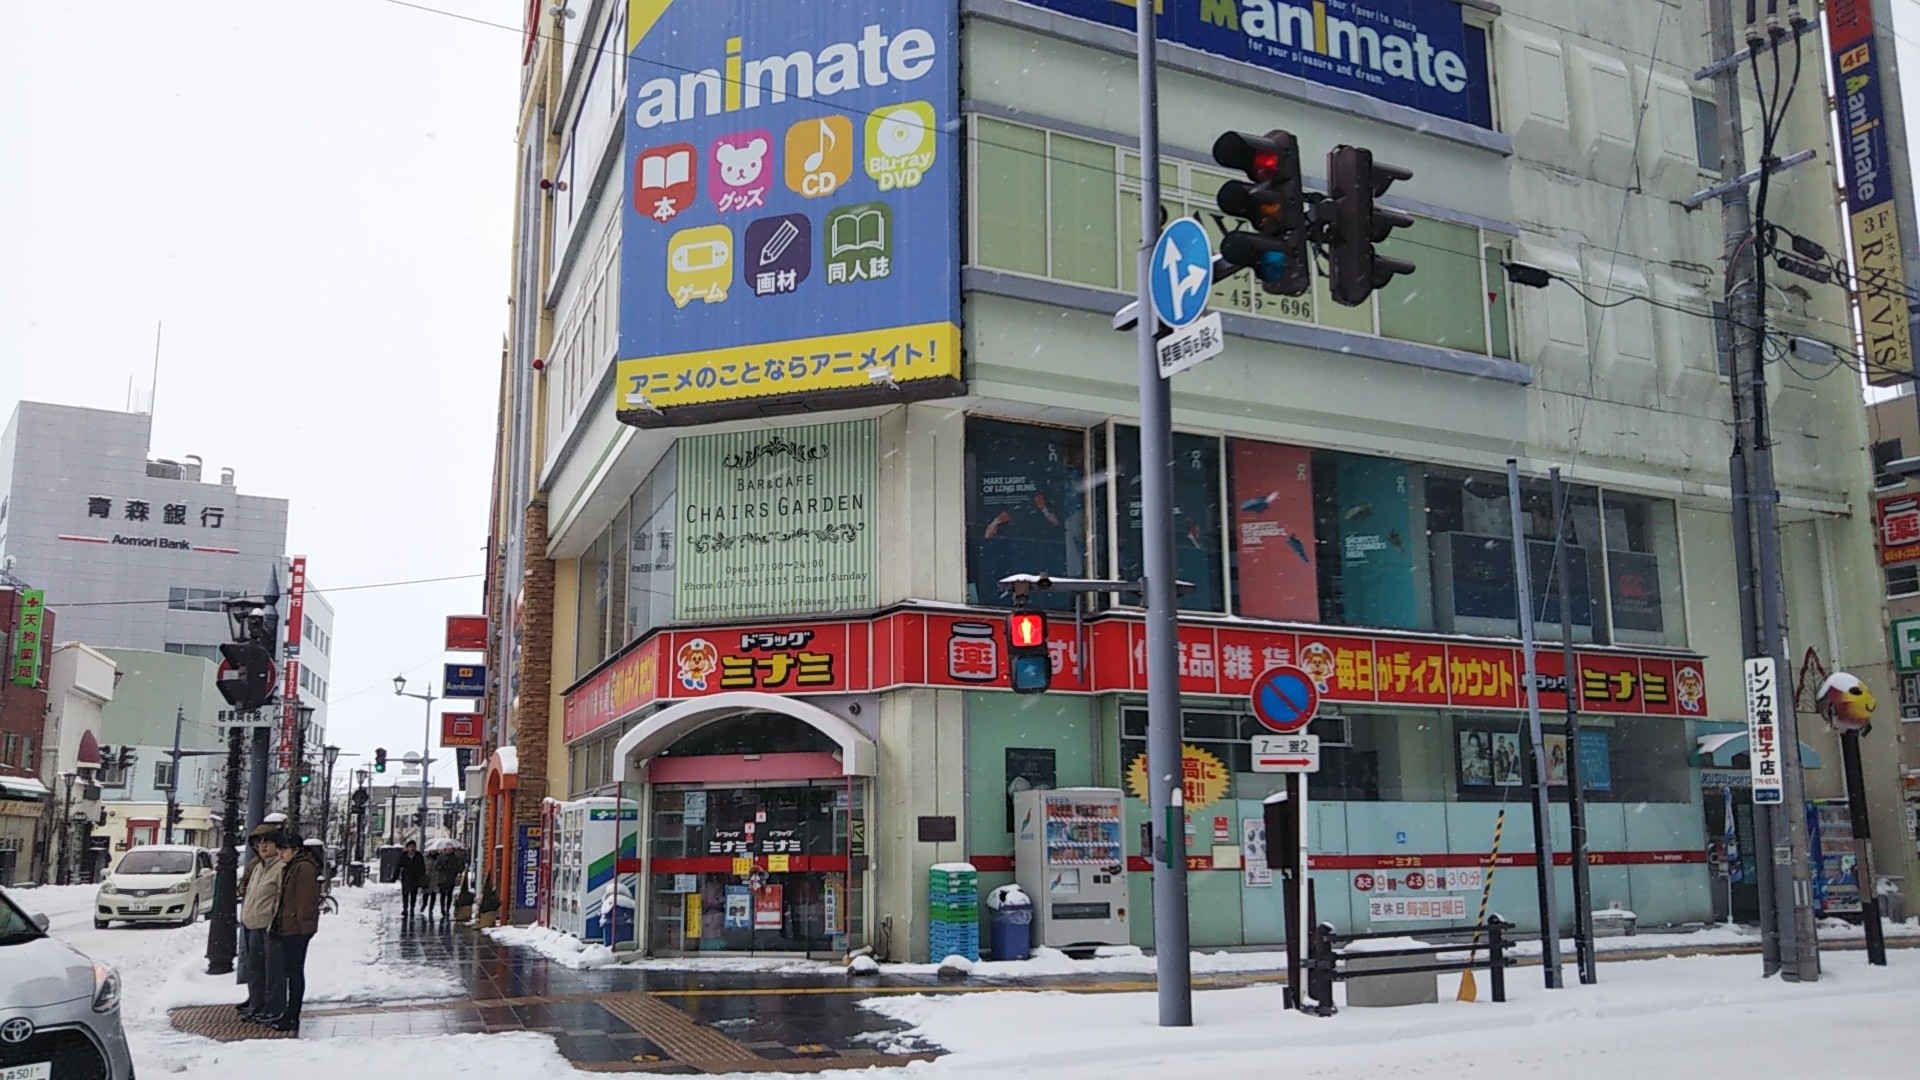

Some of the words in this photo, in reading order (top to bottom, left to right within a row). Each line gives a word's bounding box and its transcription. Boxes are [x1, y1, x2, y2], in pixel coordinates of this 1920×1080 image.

[1351, 4, 1389, 25] favorite
[1393, 17, 1417, 32] space
[1241, 0, 1467, 93] animate
[1248, 37, 1263, 51] for
[1267, 45, 1287, 58] your
[1292, 51, 1333, 72] pleasure
[1336, 63, 1352, 76] and
[1842, 47, 1866, 68] 4F
[635, 24, 936, 129] animate
[1848, 94, 1880, 202] animate
[801, 172, 837, 196] CD
[879, 169, 923, 191] DVD
[653, 196, 677, 221] 本
[718, 187, 764, 213] グッズ
[1863, 210, 1890, 234] 3F
[756, 269, 797, 295] 画材
[828, 256, 891, 285] 同人誌
[676, 282, 726, 304] ゲーム
[737, 474, 814, 492] BAR&CAFE
[87, 494, 225, 529] 青森銀行
[687, 502, 769, 524] CHAIRS
[778, 494, 863, 516] GARDEN
[112, 533, 157, 548] Aomori
[159, 538, 190, 550] Bank
[684, 582, 713, 591] Phone
[793, 572, 867, 584] Close/Sunday
[726, 565, 749, 575] Open
[18, 613, 38, 678] 天狗薬局
[741, 631, 811, 649] ドラッグ
[721, 653, 831, 686] ミナミ
[953, 641, 993, 675] 薬
[1336, 647, 1513, 698] 毎日がディスカウント
[1583, 669, 1668, 700] ミナミ
[709, 840, 748, 853] ミナミ
[762, 840, 801, 853] ミナミ
[1396, 857, 1422, 867] ミナミ
[525, 849, 538, 907] animate
